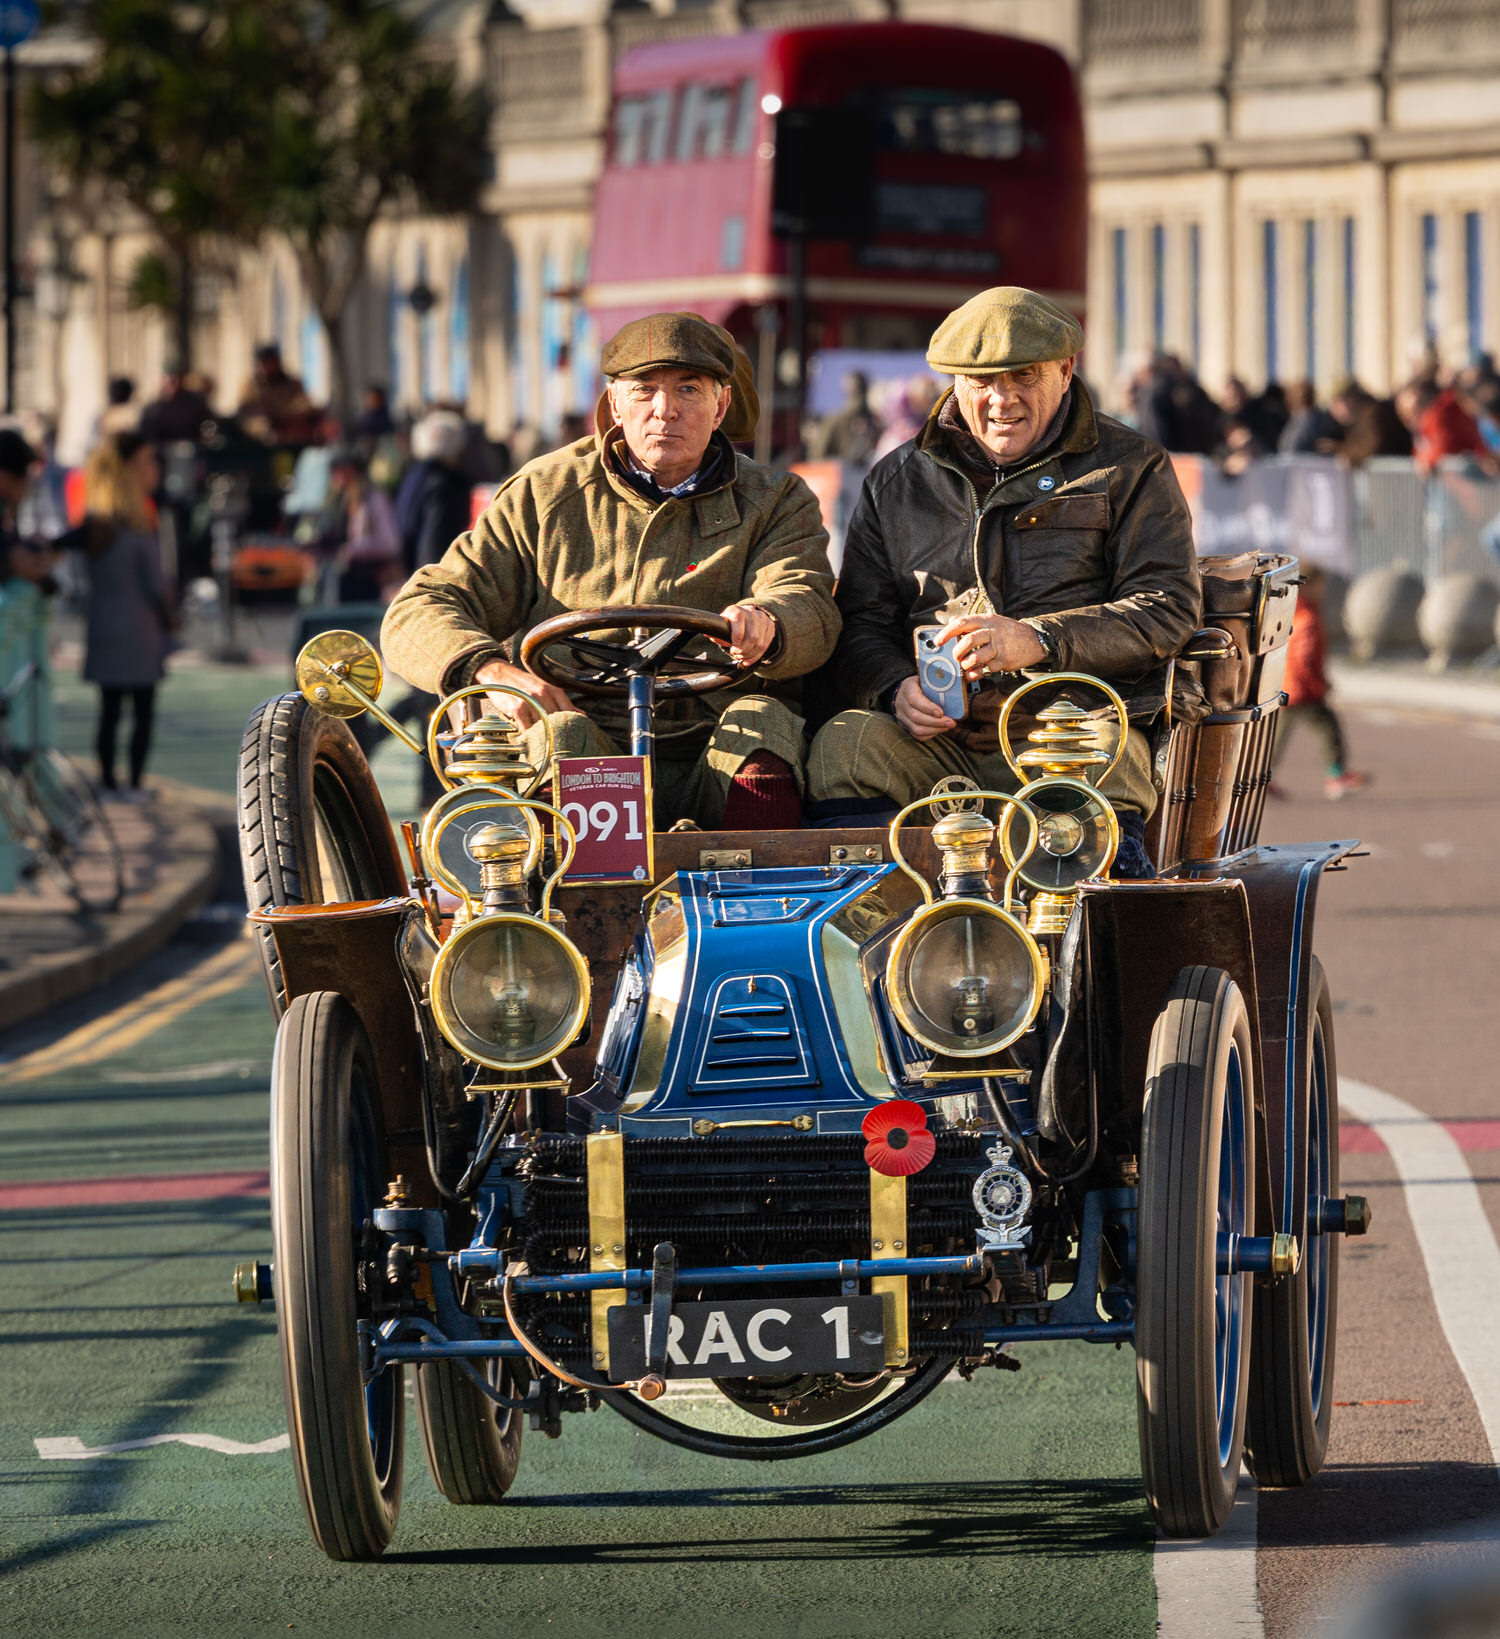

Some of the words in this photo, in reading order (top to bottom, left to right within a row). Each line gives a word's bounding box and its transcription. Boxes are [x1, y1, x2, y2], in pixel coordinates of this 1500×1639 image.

[561, 774, 592, 788] LONDON
[593, 773, 602, 783] TO
[604, 772, 641, 786] BRIGHTON
[569, 784, 594, 792] VETERAN
[560, 801, 643, 843] 091
[644, 1308, 793, 1367] RAC
[821, 1306, 850, 1359] 1
